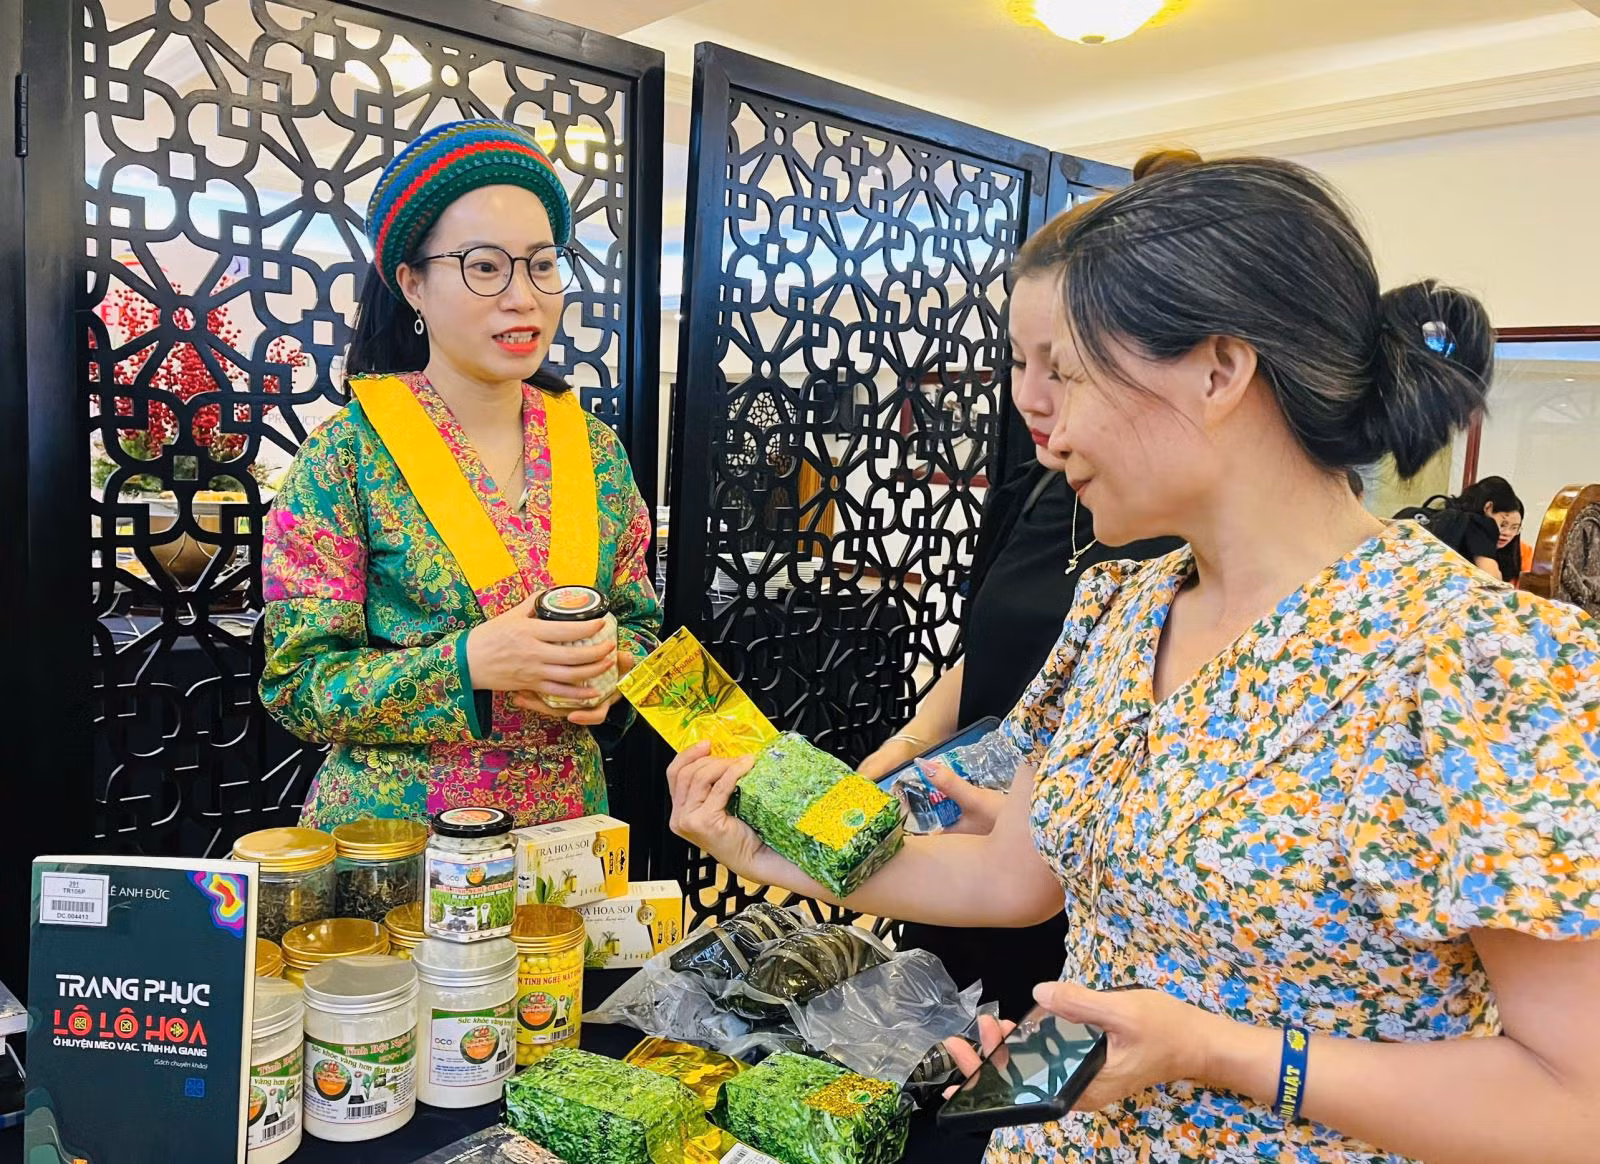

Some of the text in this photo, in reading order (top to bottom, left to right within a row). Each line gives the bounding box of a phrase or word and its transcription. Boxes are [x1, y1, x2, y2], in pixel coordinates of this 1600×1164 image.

[108, 885, 170, 900] Ê ANH ĐỨC
[576, 905, 591, 916] RÀ
[593, 906, 615, 916] HOA
[525, 977, 541, 986] TINH
[55, 974, 210, 1014] TRANG PHỤC
[53, 1004, 208, 1045] LÔ LÔ HOA
[62, 1037, 93, 1050] HUYỆN
[141, 1041, 163, 1053] TỈNH
[164, 1043, 178, 1055] HÀ
[178, 1047, 208, 1058] GIANG
[340, 1056, 357, 1068] vàng
[359, 1062, 373, 1072] hơn
